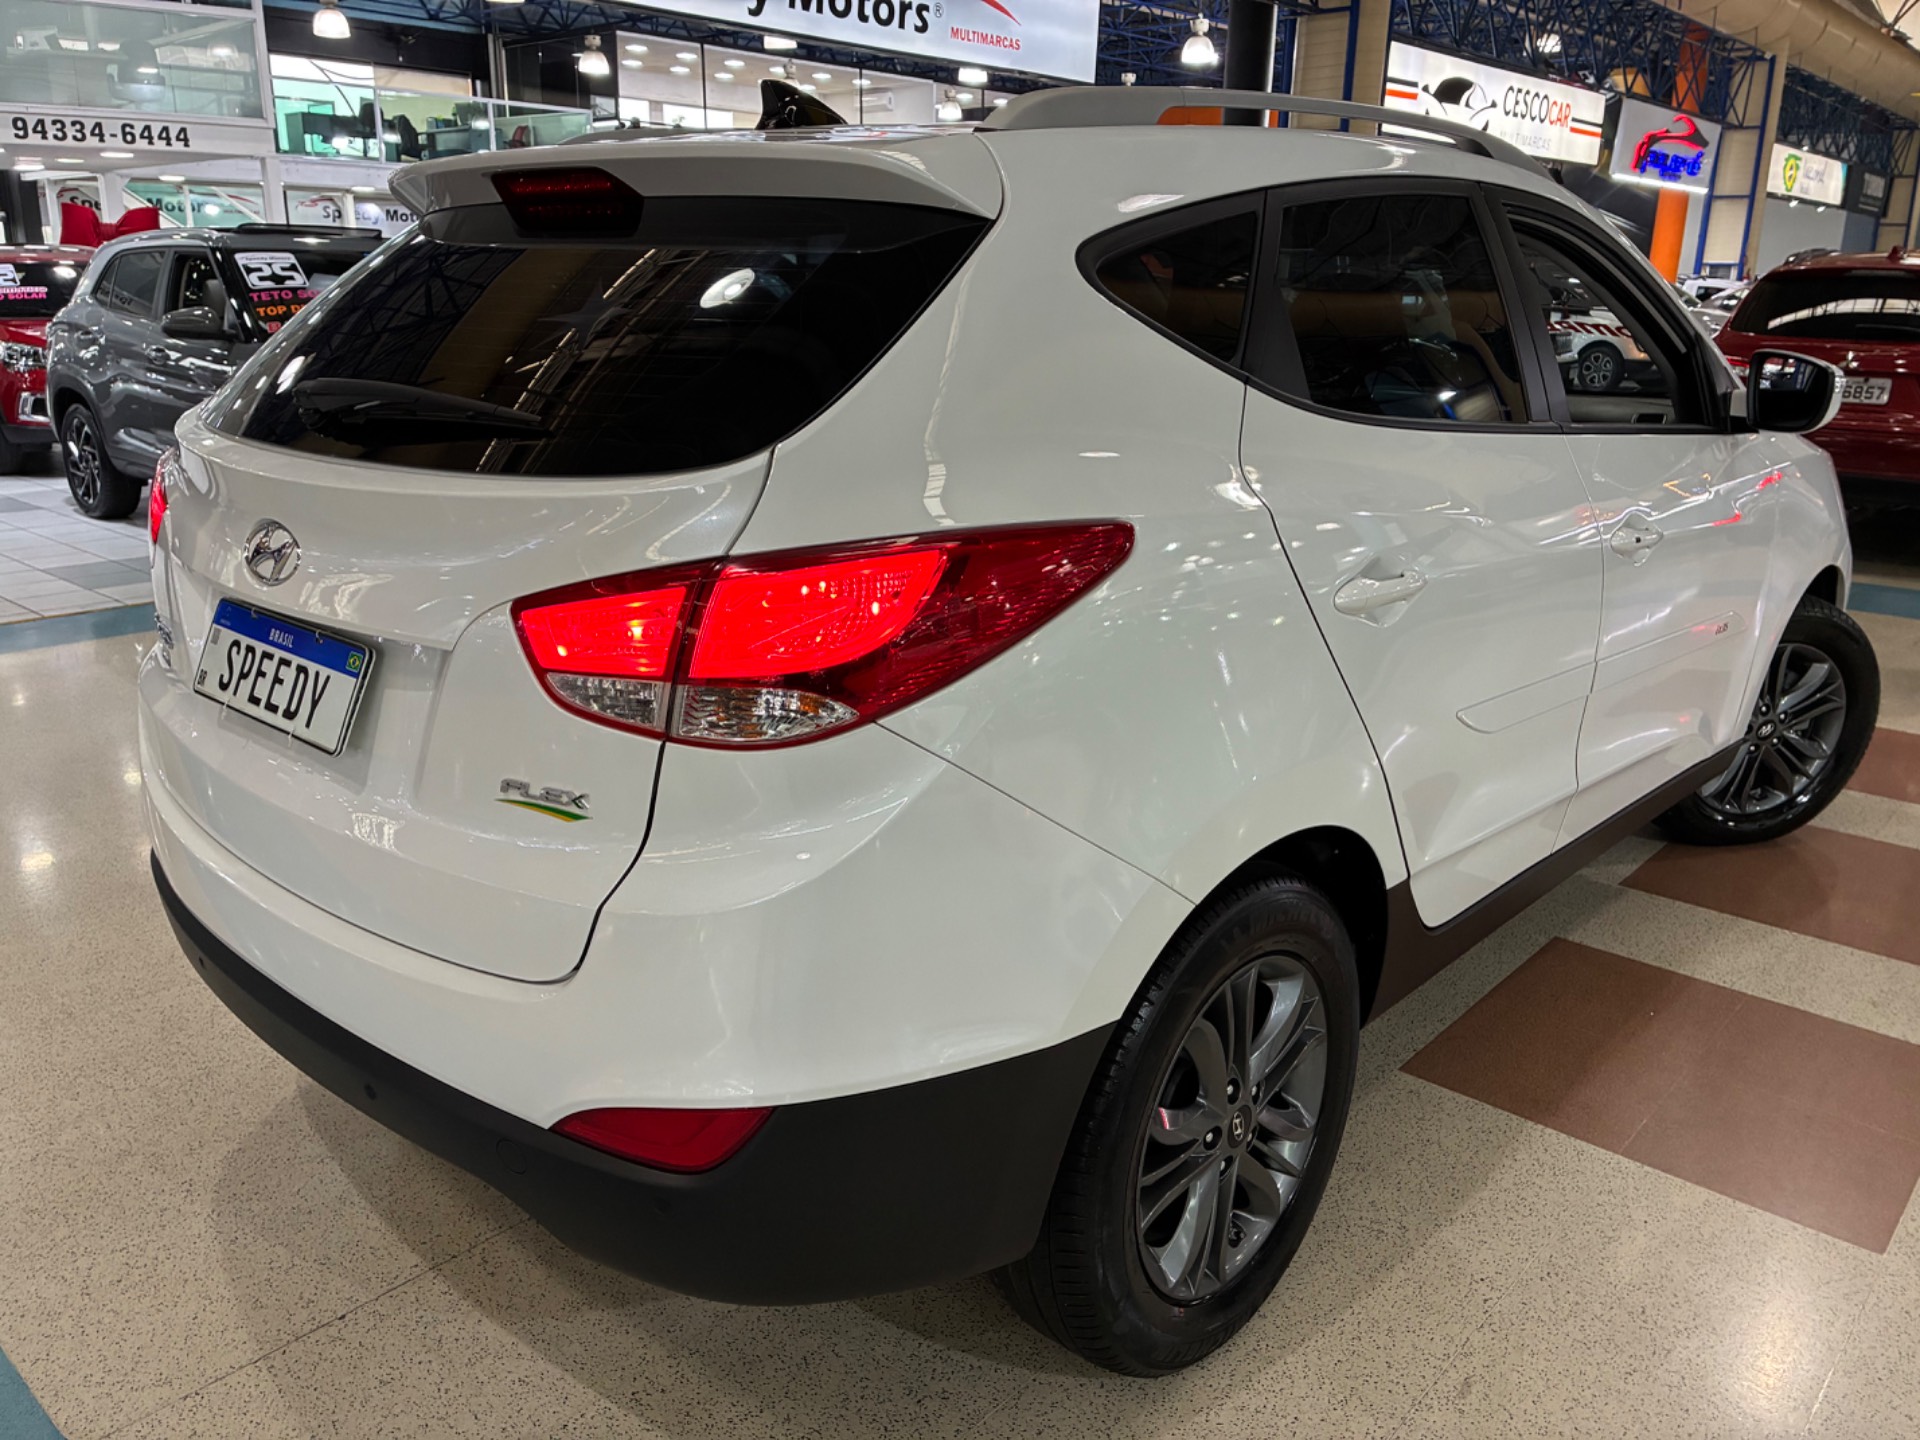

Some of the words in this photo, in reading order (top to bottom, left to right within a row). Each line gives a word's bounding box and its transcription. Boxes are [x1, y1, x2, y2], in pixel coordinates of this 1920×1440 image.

[951, 27, 1021, 51] MULTIMARCAS
[1503, 85, 1571, 128] CESCOCAR
[11, 116, 191, 148] 94334-6444
[247, 263, 304, 286] 25
[249, 290, 293, 302] TETO
[256, 305, 287, 317] TOP
[1842, 385, 1886, 400] 6857
[268, 627, 294, 649] BRASIL
[218, 639, 331, 729] SPEEDY
